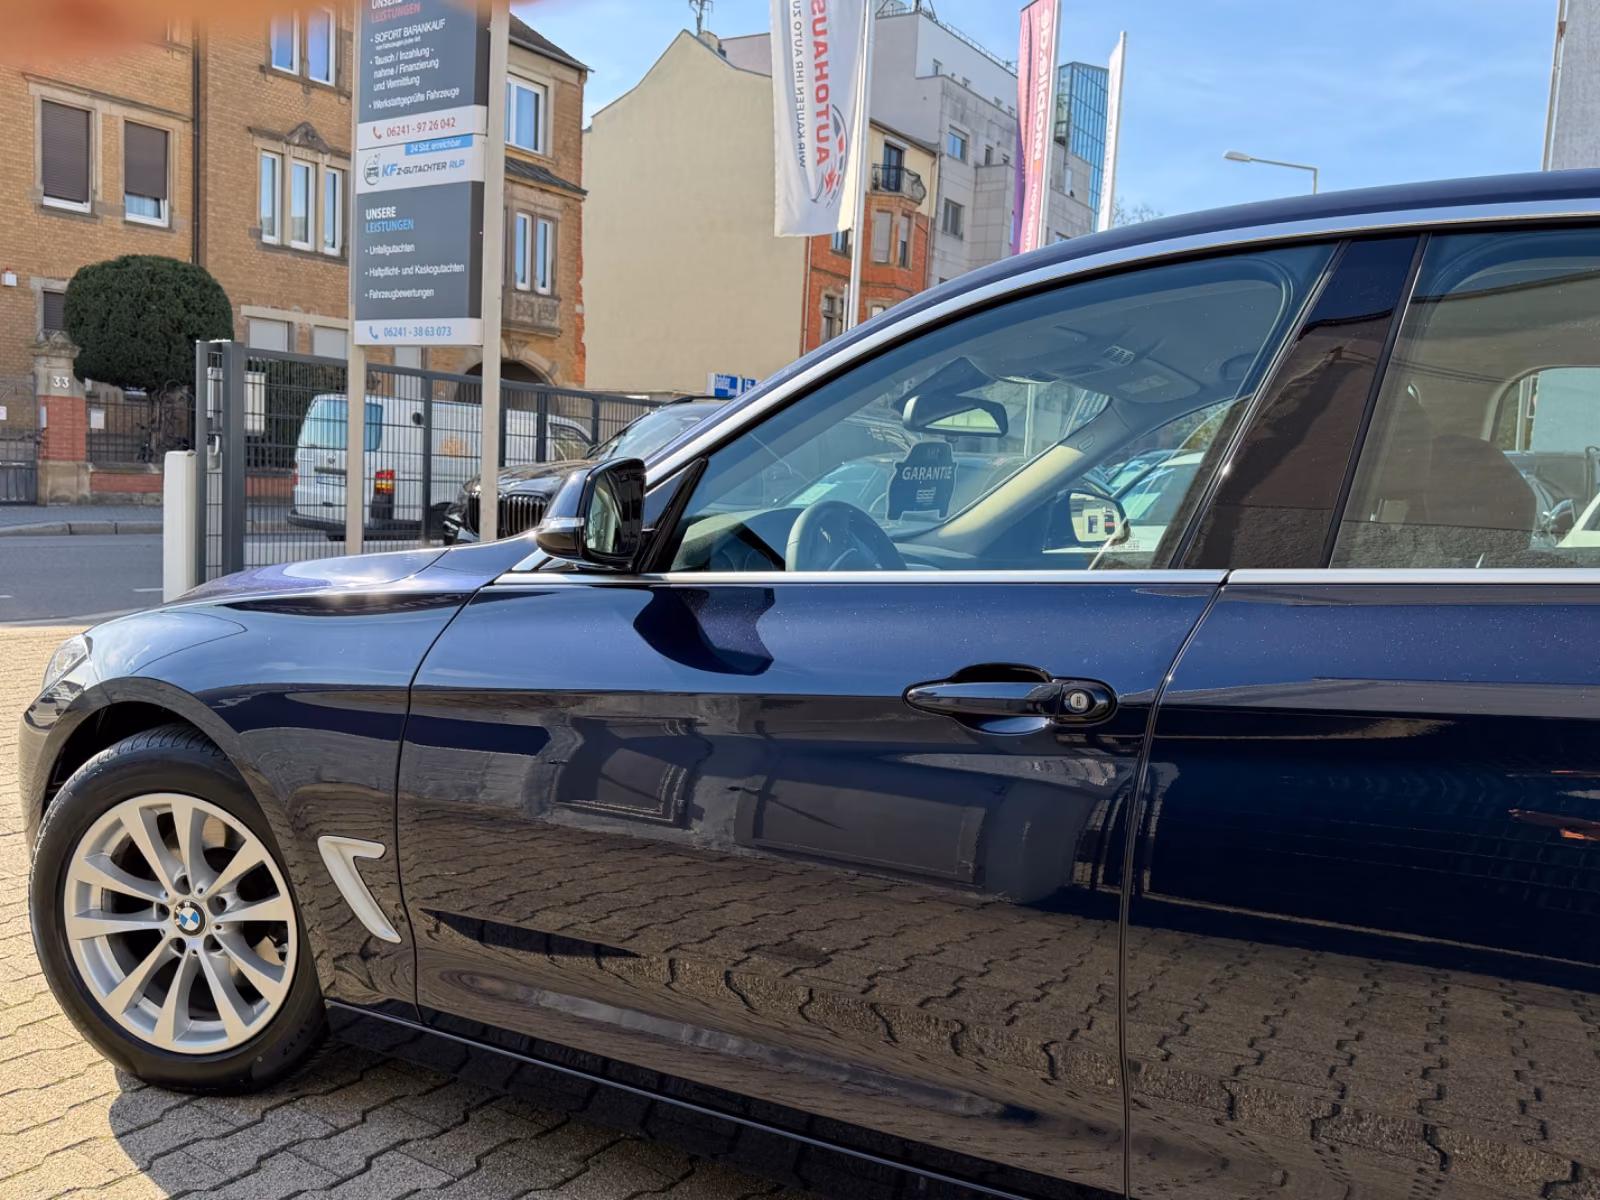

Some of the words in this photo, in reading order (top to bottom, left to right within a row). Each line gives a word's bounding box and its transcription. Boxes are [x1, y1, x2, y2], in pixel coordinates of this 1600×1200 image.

[374, 28, 402, 43] SOFORT
[403, 18, 446, 37] BARANKAUF
[374, 53, 394, 65] Tausch
[374, 66, 394, 78] nahme
[399, 58, 439, 74] Finanzierung
[373, 80, 385, 92] und
[386, 75, 420, 88] Vermittlung
[373, 92, 425, 110] Werkstattgeprüfte
[426, 87, 460, 100] Fahrzeuge
[386, 124, 410, 138] 06241
[416, 122, 426, 133] 97
[428, 120, 438, 130] 26
[440, 116, 456, 129] 042
[448, 158, 465, 168] RLP
[365, 206, 396, 220] UNSERE
[365, 218, 414, 233] LEISTUNGEN
[369, 243, 415, 256] Unfallgutachten
[369, 266, 400, 278] Haftpflicht-
[402, 265, 414, 276] und
[414, 262, 464, 276] Kaskogutachten
[369, 288, 434, 300] Fahrzeugbewertungen
[384, 326, 407, 337] 06241
[413, 326, 424, 337] 38
[424, 326, 436, 337] 63
[436, 326, 452, 336] 073
[52, 376, 69, 388] 33
[902, 466, 952, 480] GARANTIE
